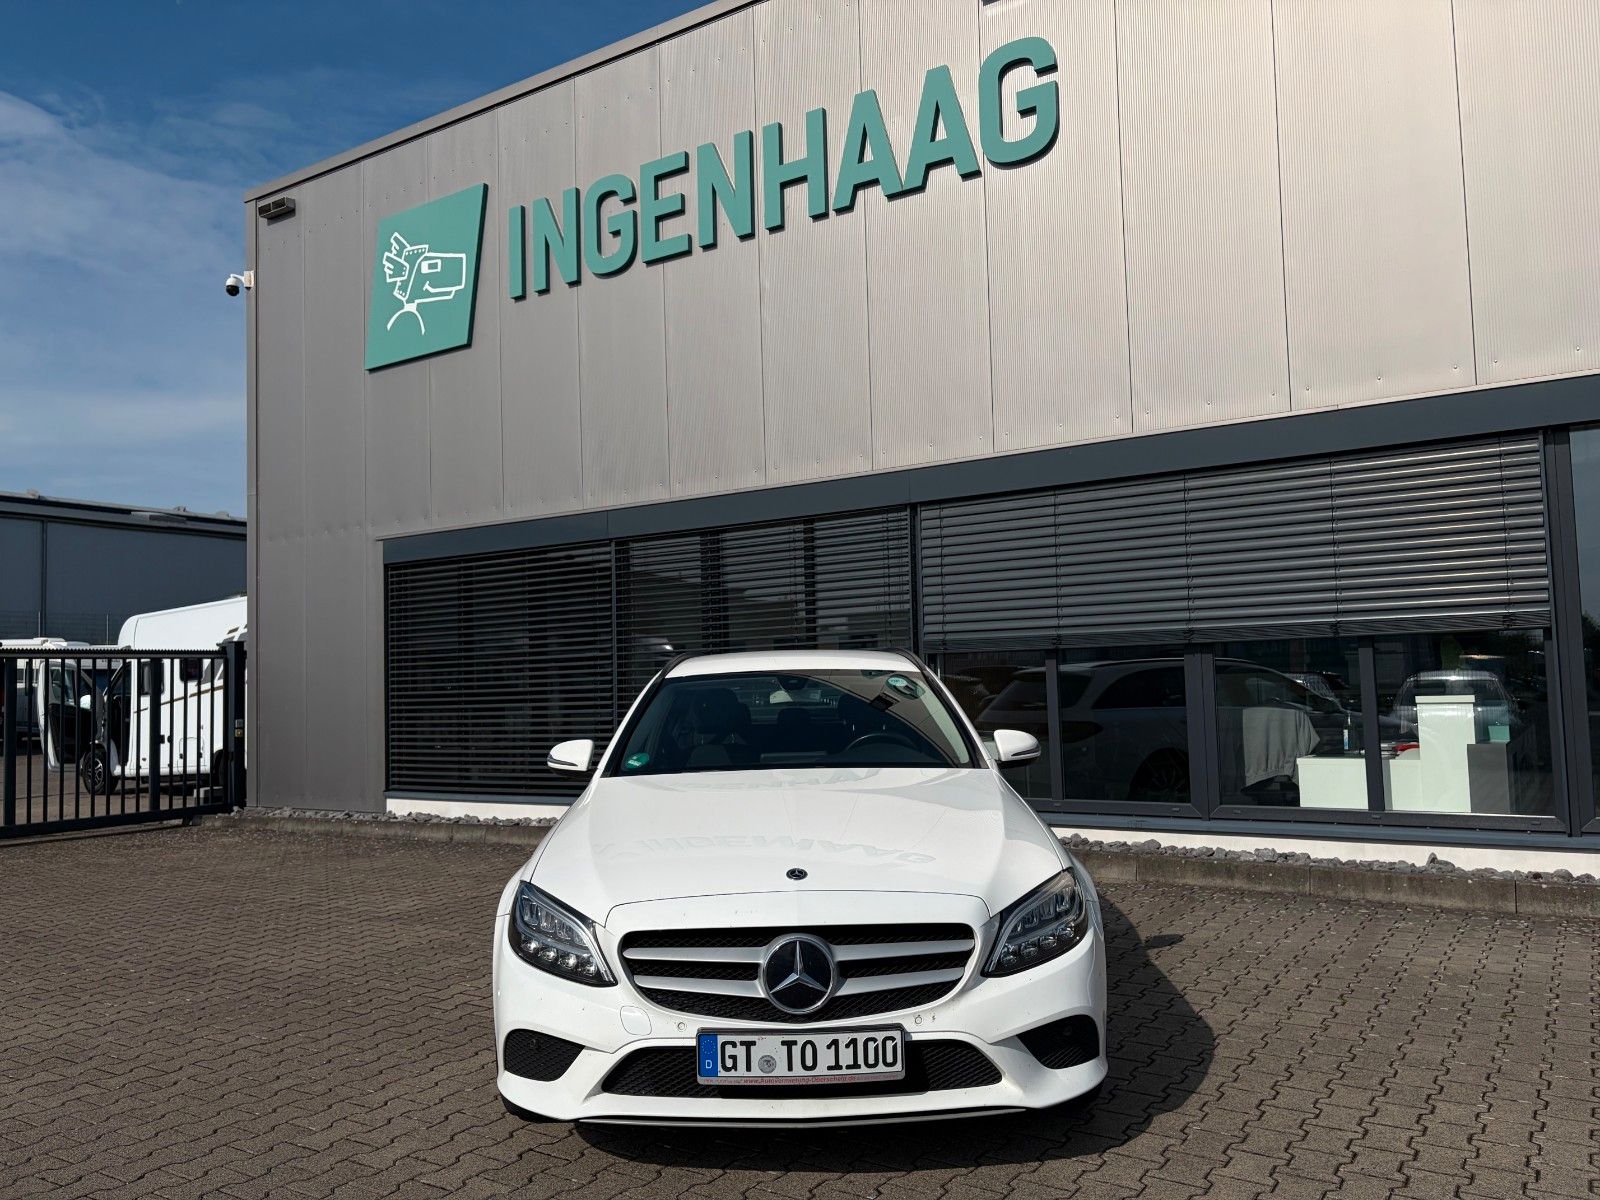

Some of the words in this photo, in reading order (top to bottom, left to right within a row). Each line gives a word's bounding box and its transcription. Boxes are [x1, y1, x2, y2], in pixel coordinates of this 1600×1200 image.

[508, 36, 1060, 301] INGENHAAG
[705, 1059, 713, 1070] D
[720, 1040, 756, 1072] GT
[780, 1039, 818, 1072] TO
[826, 1036, 898, 1071] 1100
